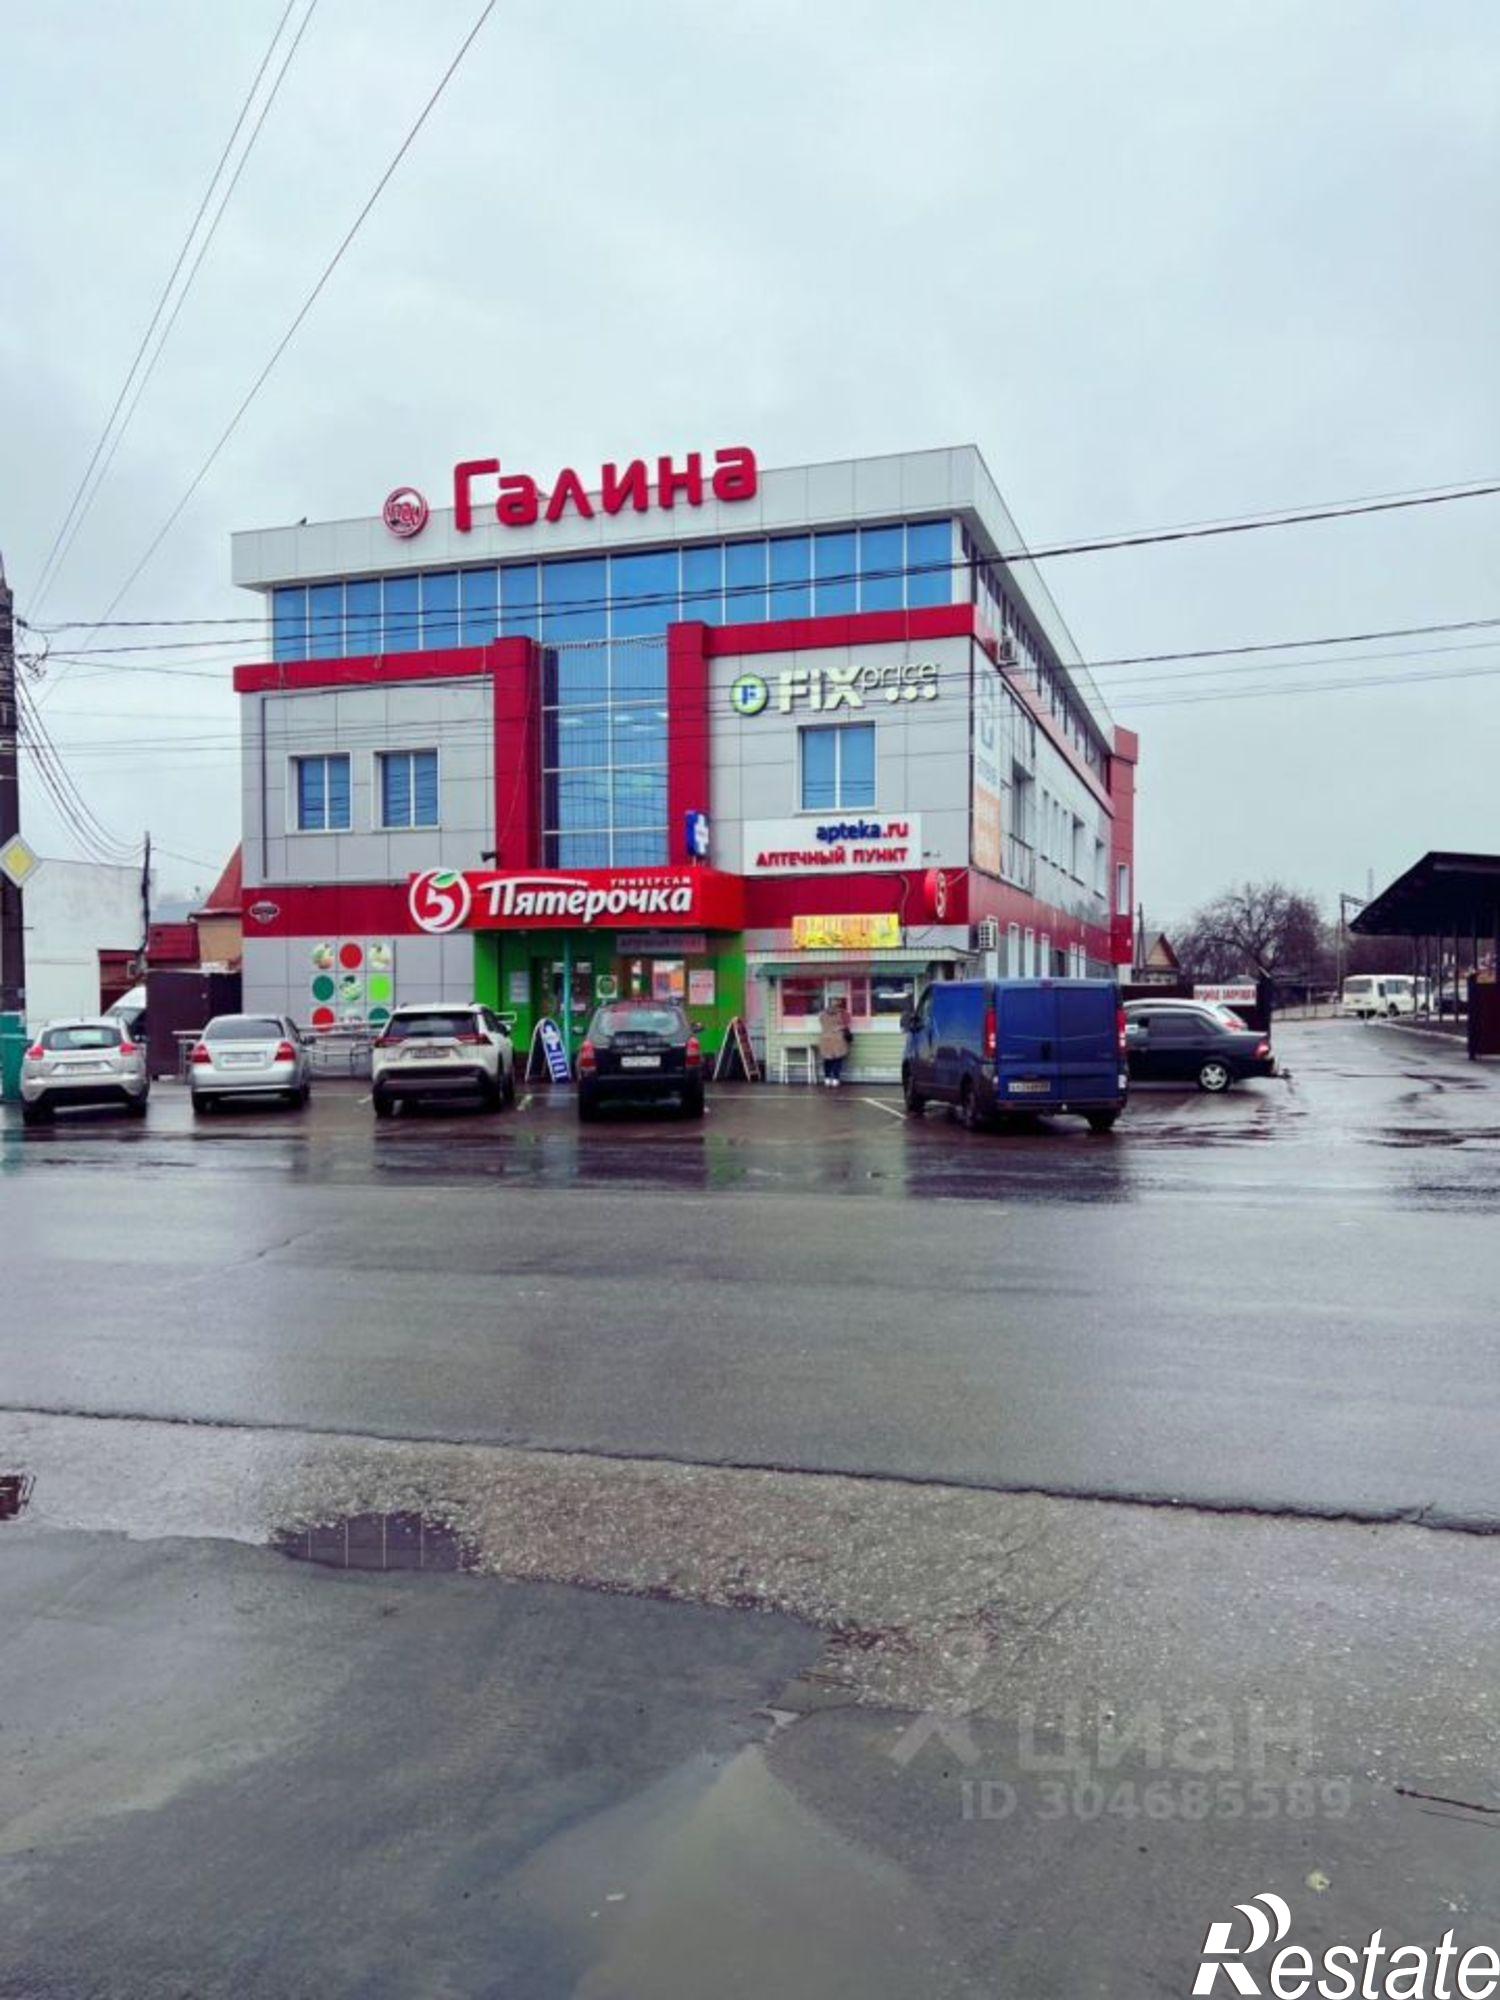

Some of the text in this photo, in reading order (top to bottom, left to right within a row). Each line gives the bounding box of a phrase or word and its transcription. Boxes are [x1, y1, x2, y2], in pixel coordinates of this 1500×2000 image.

[454, 446, 758, 533] Галина
[778, 663, 938, 714] FIX price
[756, 845, 909, 867] АПТЕЧНЫЙ ПУНКТ
[815, 820, 909, 844] apteka.ru
[477, 876, 693, 924] Пятерочка
